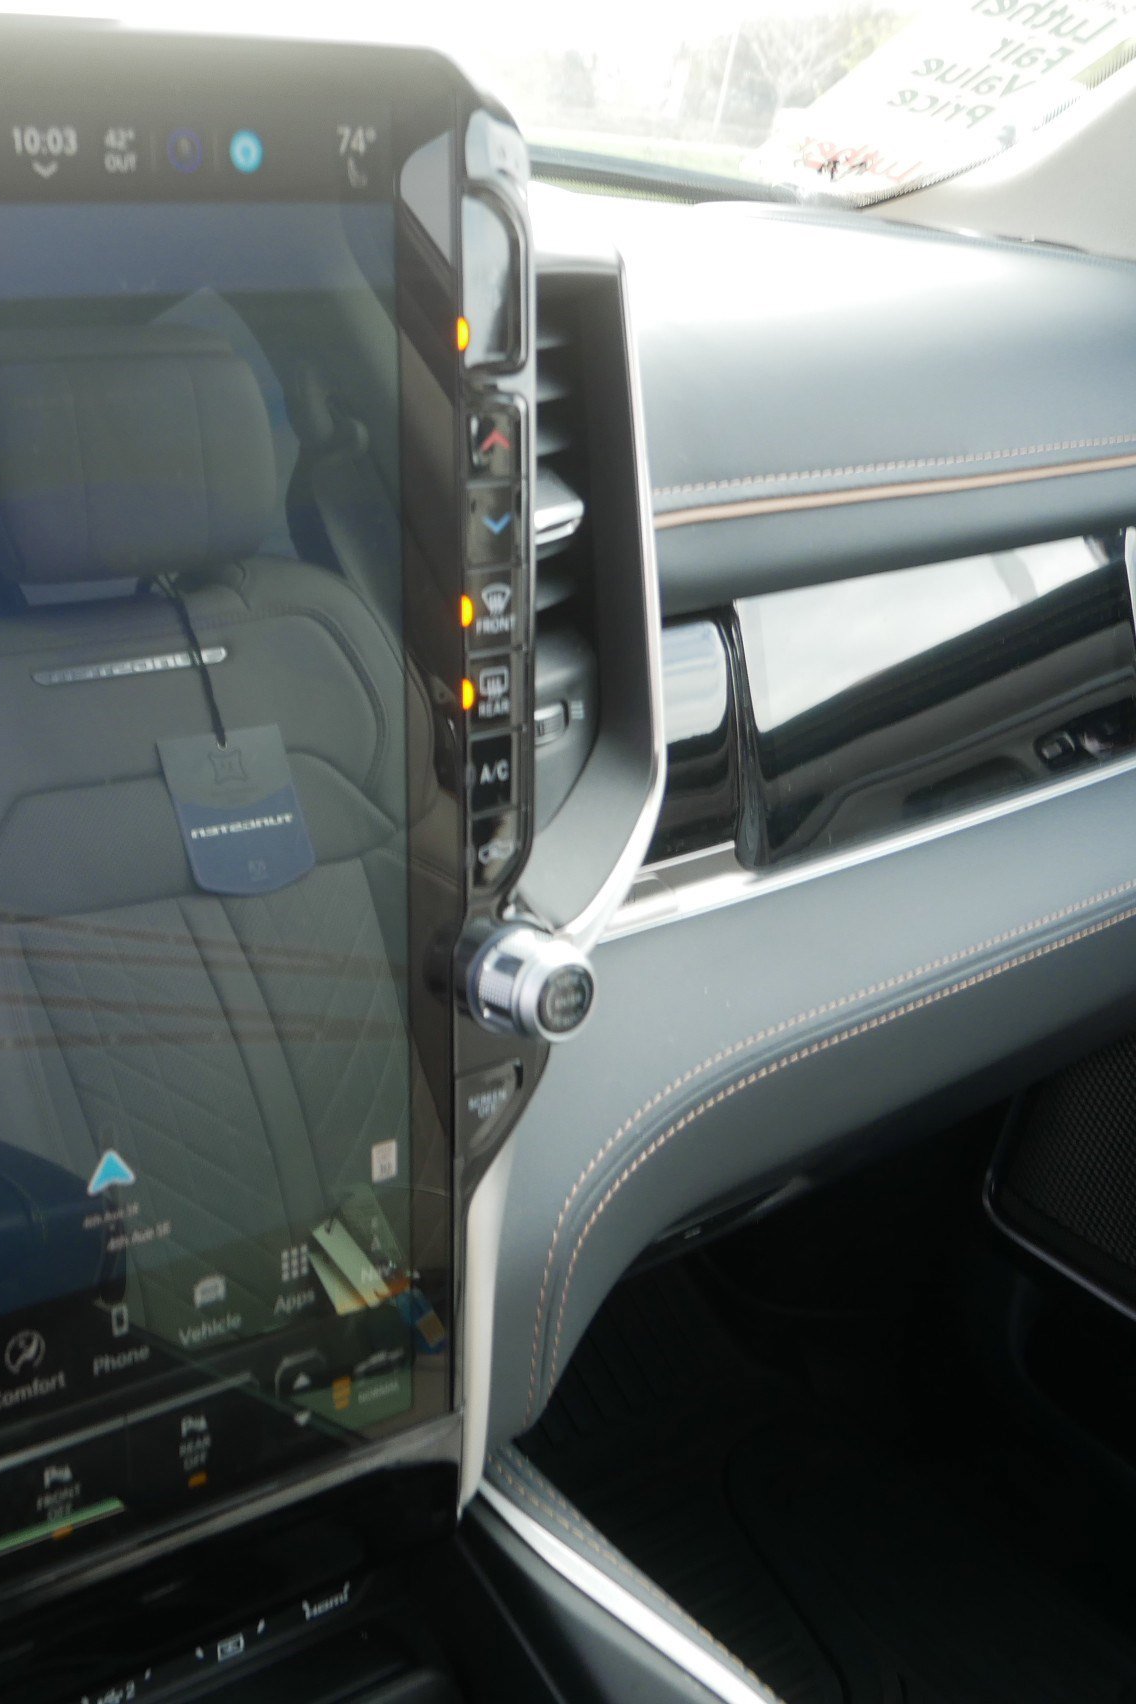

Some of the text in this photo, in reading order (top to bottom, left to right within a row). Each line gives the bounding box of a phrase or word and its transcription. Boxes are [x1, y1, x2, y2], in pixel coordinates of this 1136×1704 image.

[11, 125, 79, 157] 10:03
[476, 614, 515, 636] FRONT
[478, 699, 510, 719] REAR
[480, 758, 510, 785] A/C
[273, 1290, 317, 1316] Apps
[178, 1313, 243, 1348] Vehicle
[92, 1345, 151, 1377] Phone
